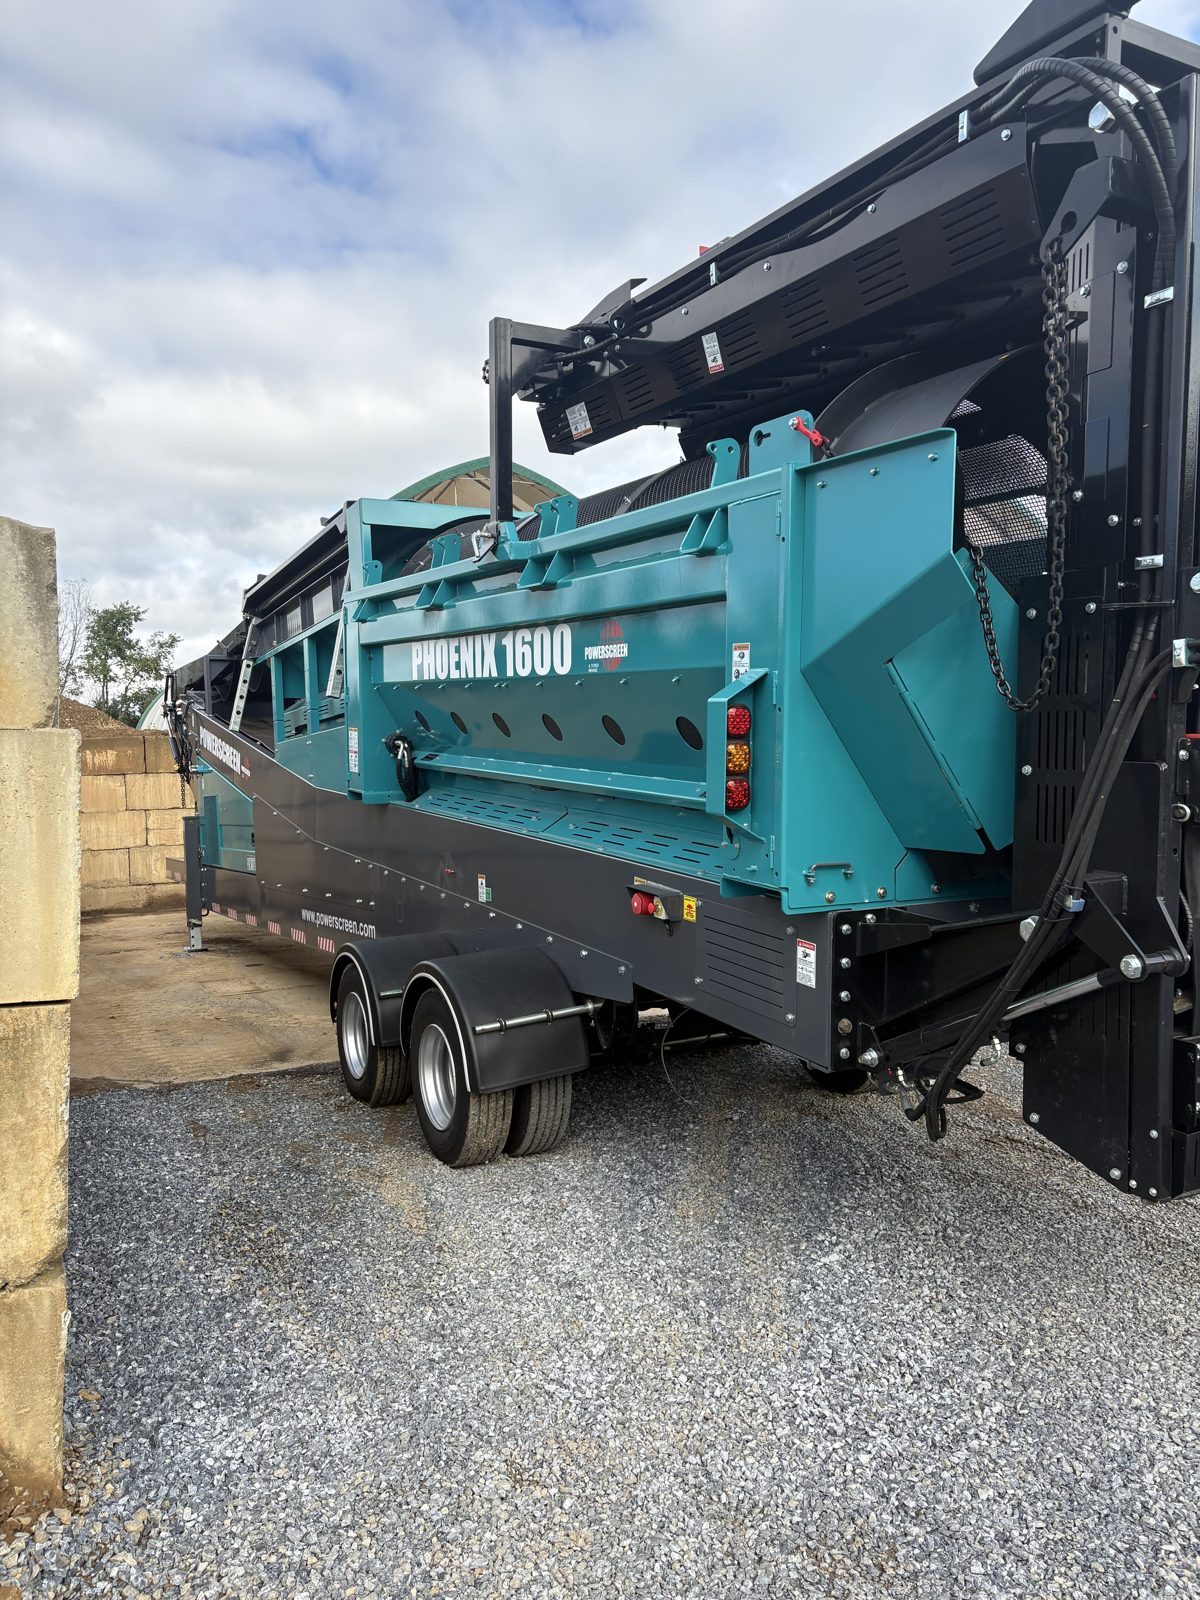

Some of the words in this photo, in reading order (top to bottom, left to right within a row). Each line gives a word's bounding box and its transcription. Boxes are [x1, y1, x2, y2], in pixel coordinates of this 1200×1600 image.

[411, 633, 498, 681] PHOENIX
[501, 623, 572, 677] 1600
[584, 643, 628, 660] POWERSCREEN
[200, 725, 241, 775] POWERSCREEN
[300, 908, 376, 940] www.powerscreen.com
